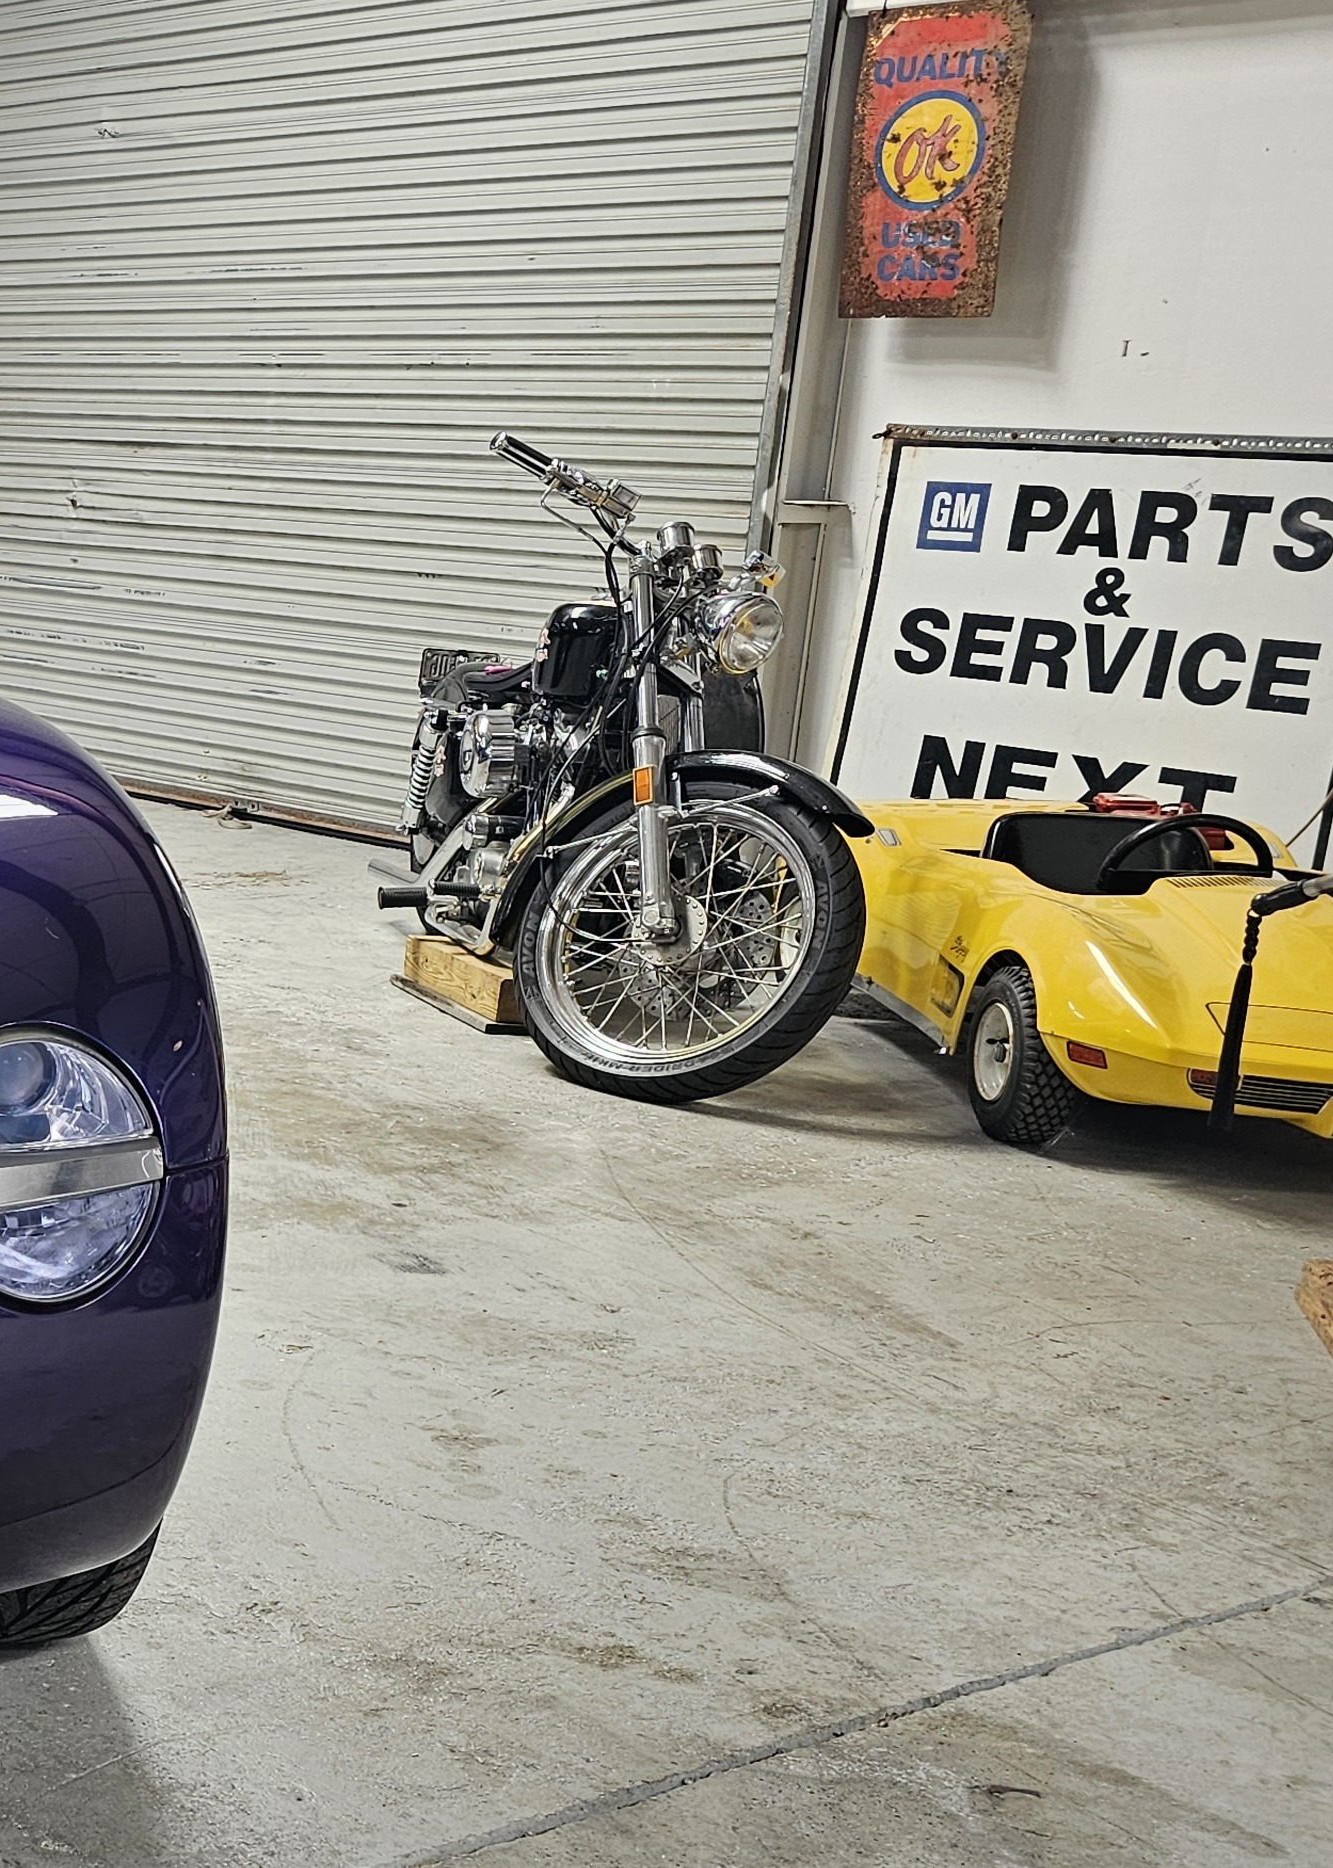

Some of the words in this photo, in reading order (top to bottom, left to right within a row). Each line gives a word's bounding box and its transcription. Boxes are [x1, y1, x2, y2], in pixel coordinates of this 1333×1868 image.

[894, 114, 961, 185] OK
[877, 254, 961, 282] CARS
[881, 219, 962, 249] USED
[929, 491, 981, 529] GM
[1007, 484, 1333, 573] PARTS
[1083, 566, 1132, 618] &
[894, 607, 1323, 716] SERVICE
[910, 734, 1238, 814] NEXT
[521, 911, 540, 979] AVON
